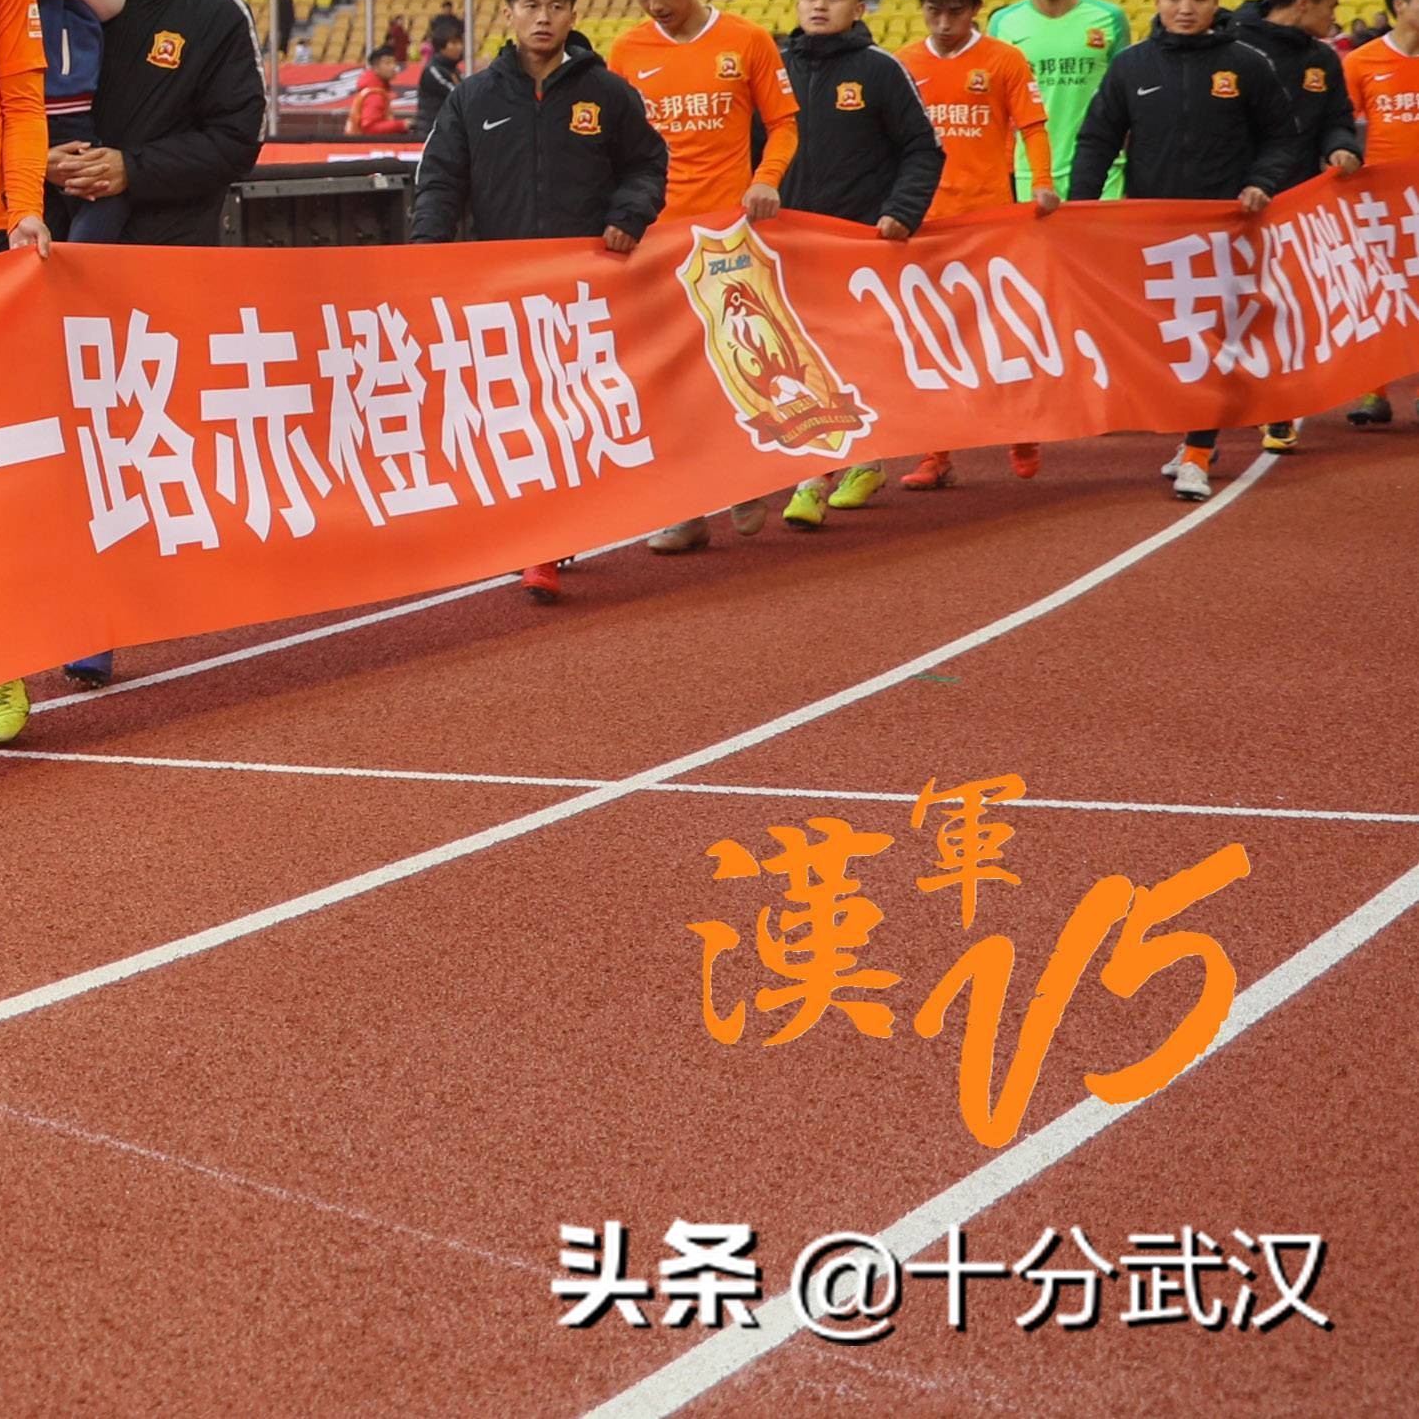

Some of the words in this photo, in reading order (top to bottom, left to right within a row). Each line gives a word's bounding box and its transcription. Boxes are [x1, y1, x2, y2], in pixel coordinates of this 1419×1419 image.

[1028, 57, 1096, 75] 邦银行
[1375, 92, 1419, 111] 众邦
